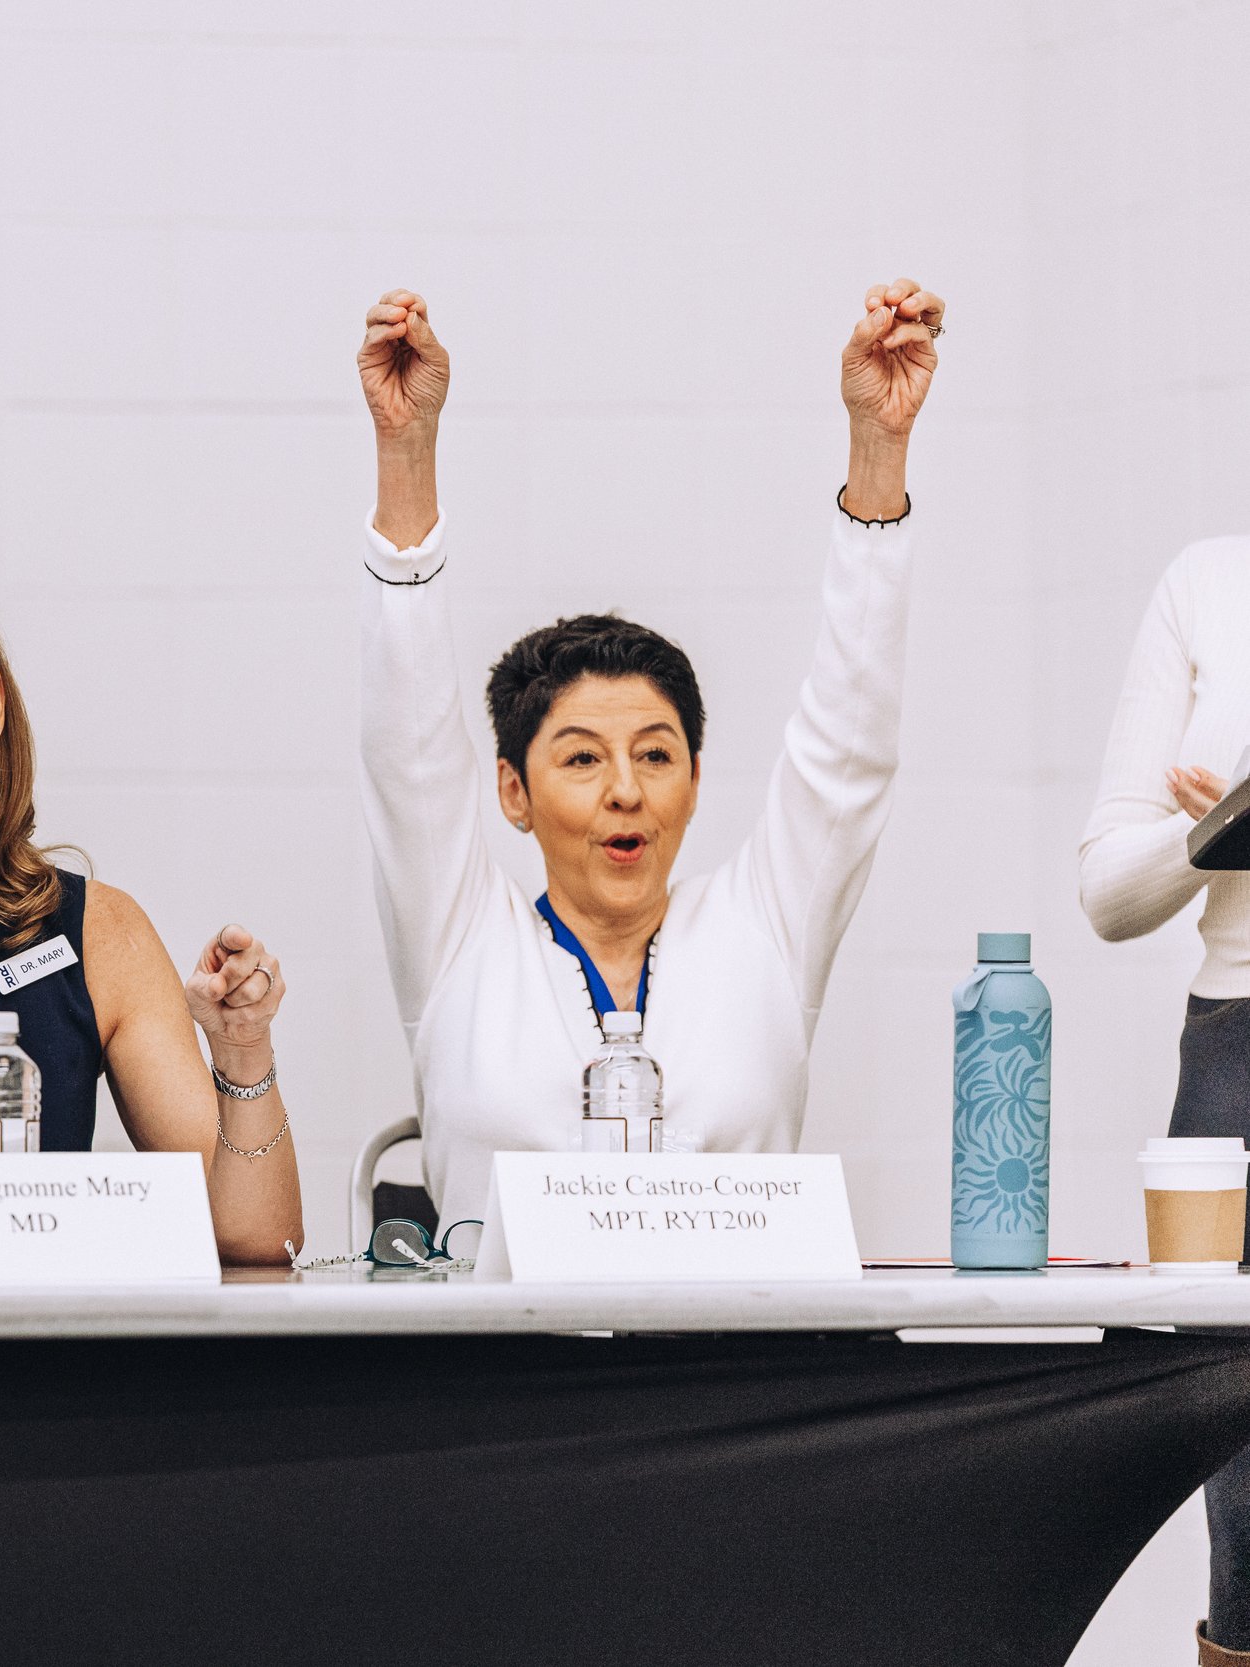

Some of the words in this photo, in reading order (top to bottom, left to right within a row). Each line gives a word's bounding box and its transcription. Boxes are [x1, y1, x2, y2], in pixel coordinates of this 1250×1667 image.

[20, 961, 38, 974] DR.
[37, 947, 65, 966] MARY
[86, 1175, 152, 1203] Mary
[542, 1174, 617, 1196] Jackie
[625, 1174, 802, 1202] Castro-Cooper
[10, 1212, 59, 1233] MD
[588, 1210, 657, 1233] MPT,
[664, 1210, 767, 1231] RYT200
